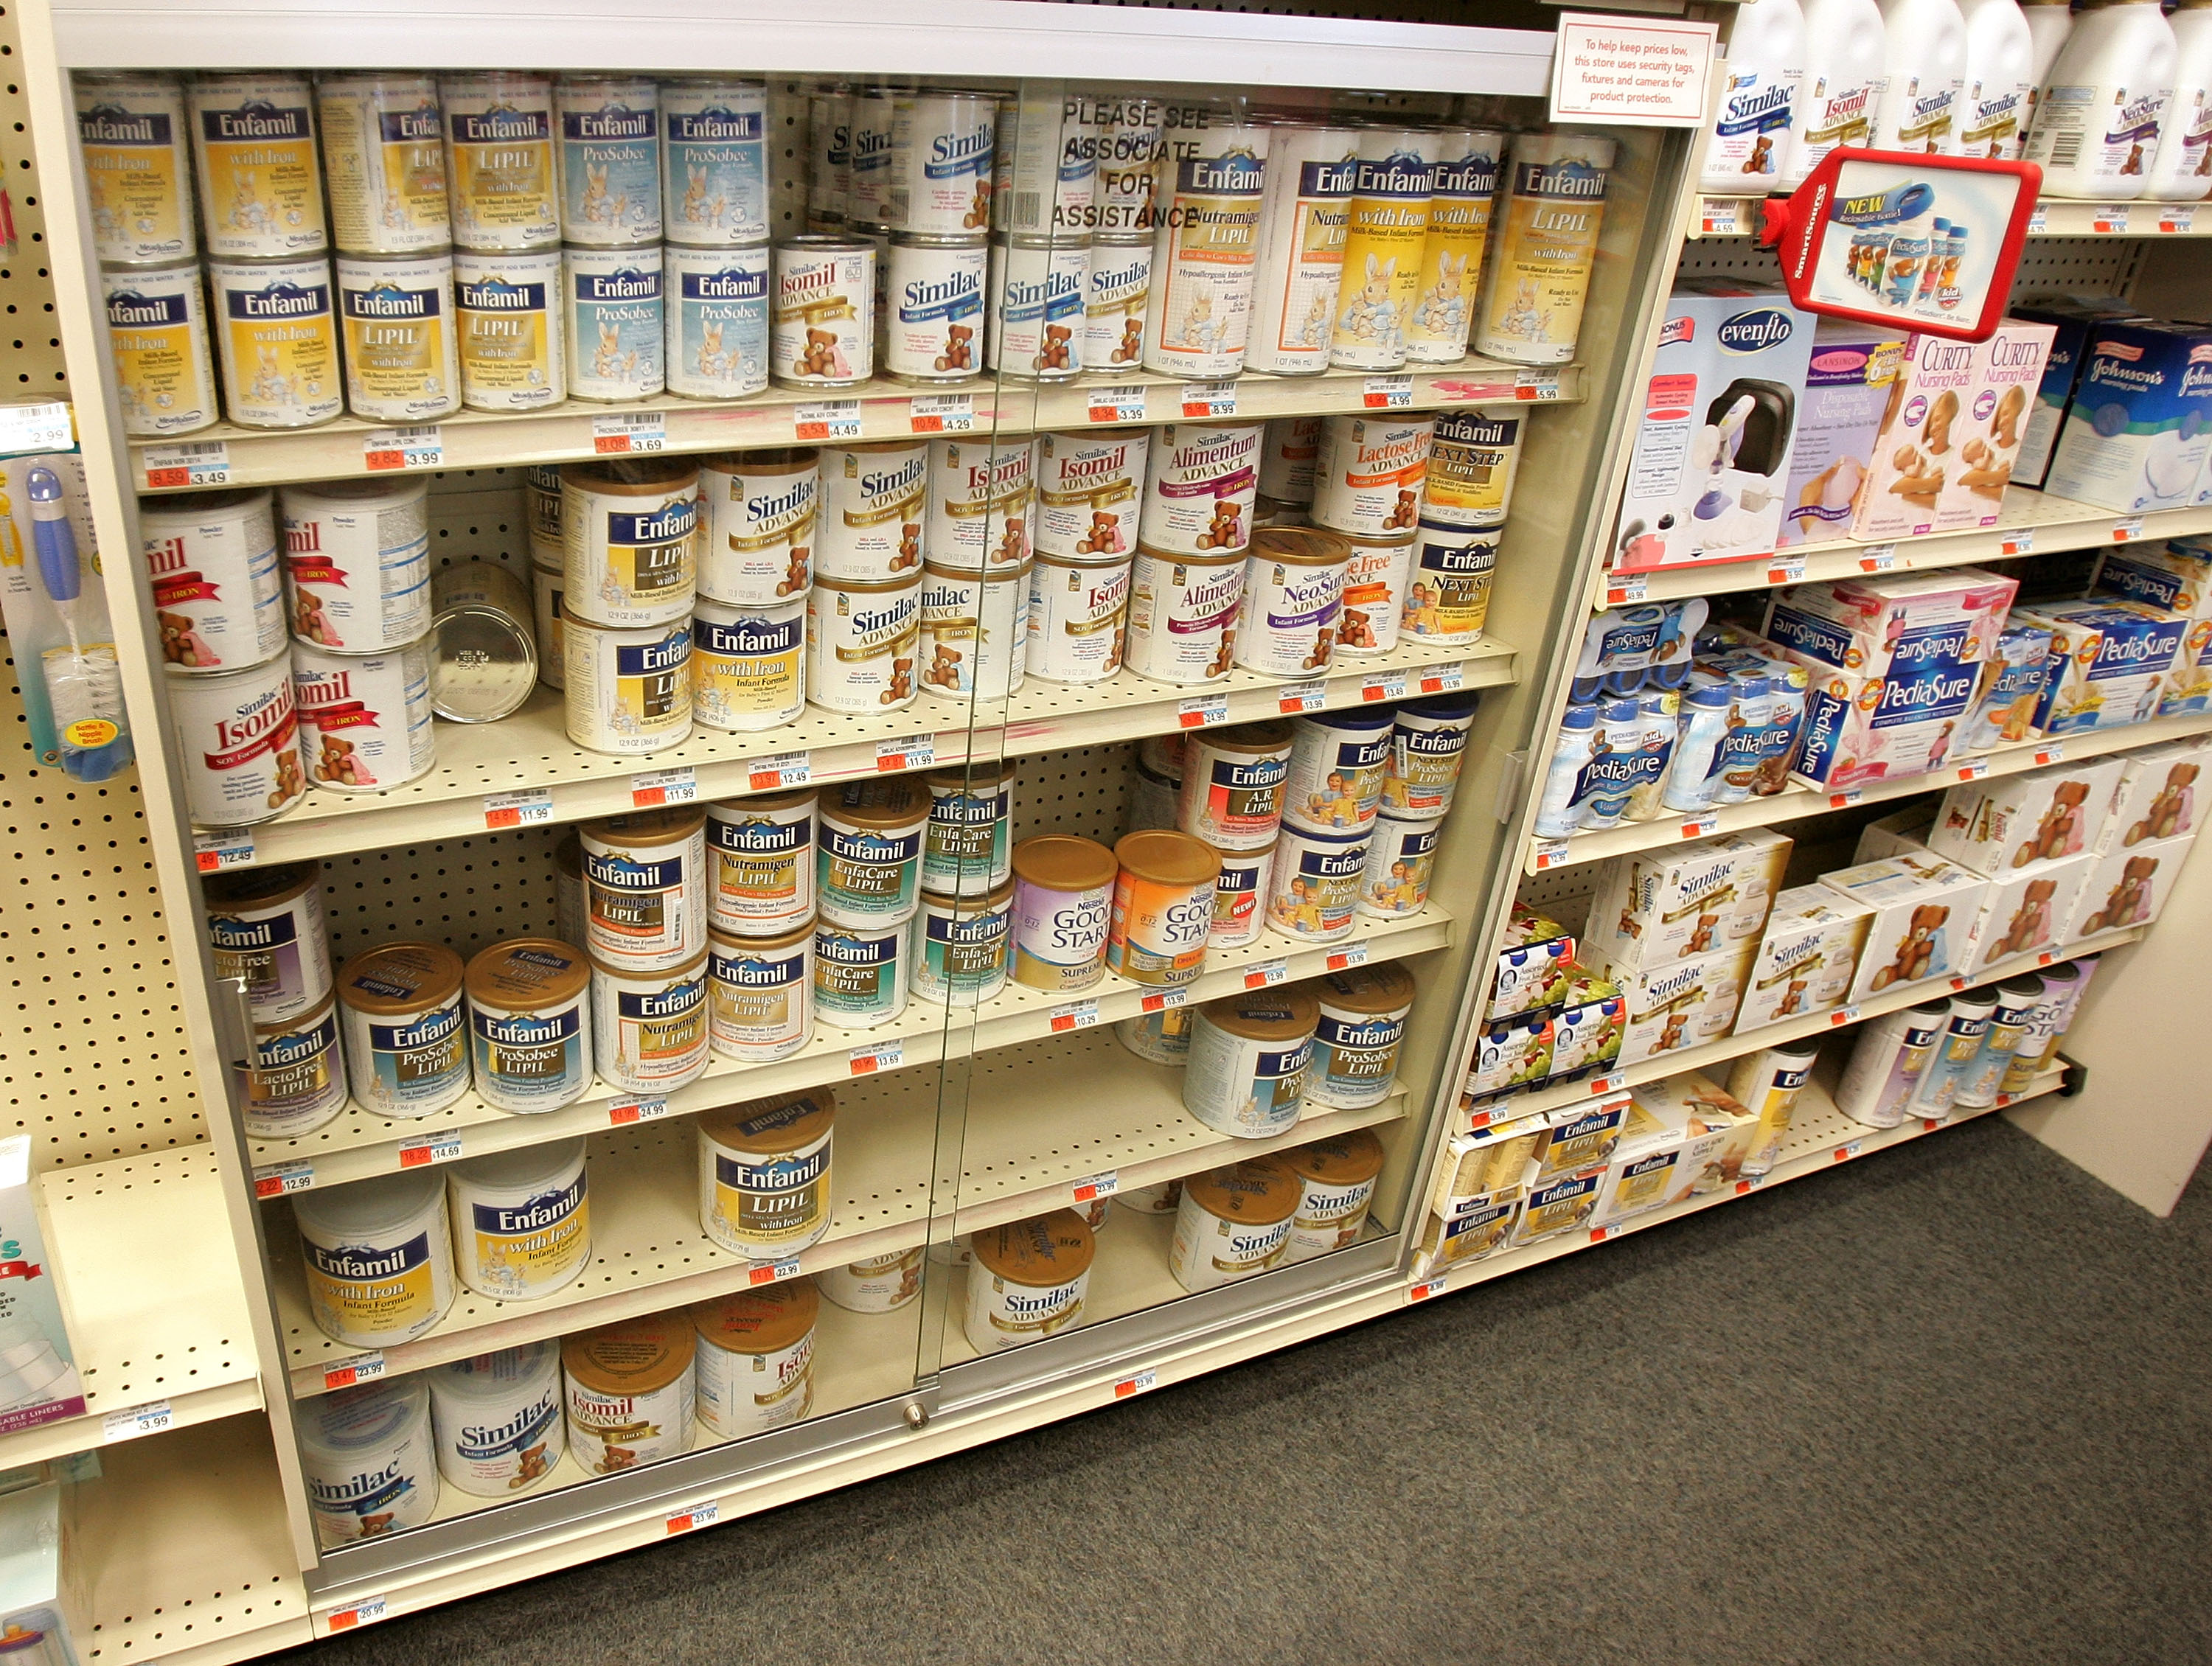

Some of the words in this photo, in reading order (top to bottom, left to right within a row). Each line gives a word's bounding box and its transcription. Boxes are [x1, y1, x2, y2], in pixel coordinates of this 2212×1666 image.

[1586, 38, 1596, 50] To
[1599, 40, 1617, 52] help
[1621, 41, 1641, 55] keep
[1644, 43, 1668, 56] prices
[1672, 44, 1688, 56] low,
[1575, 55, 1590, 66] this
[1593, 58, 1615, 68] store
[1618, 60, 1636, 69] uses
[1639, 60, 1672, 73] security
[1675, 63, 1694, 74] tags,
[1582, 72, 1614, 84] fixtures
[1617, 74, 1632, 85] and
[1635, 77, 1669, 87] cameras
[1672, 78, 1685, 88] for
[1590, 91, 1624, 102] product
[1627, 93, 1672, 104] protection.
[1725, 86, 1796, 122] Similac
[1825, 87, 1870, 119] Isomil
[1913, 90, 1956, 117] Similac
[1975, 91, 2021, 120] Similac
[220, 113, 296, 137] Enfamil
[467, 116, 538, 138] Enfamil
[580, 115, 647, 136] Enfamil
[683, 118, 749, 136] Enfamil
[1064, 102, 1158, 127] PLEASE
[1164, 107, 1212, 130] SEE
[684, 148, 748, 162] ProSobee
[1064, 138, 1200, 162] ASSOCIATE
[1106, 173, 1152, 194] FOR
[1358, 165, 1433, 192] Enfamil
[1526, 167, 1604, 195] Enfamil
[1843, 195, 1887, 213] NEW
[1054, 206, 1198, 228] ASSISTANCE
[1358, 209, 1395, 226] with
[1531, 209, 1588, 231] LIPIL
[594, 276, 655, 296] Enfamil
[699, 276, 761, 296] Enfamil
[780, 262, 837, 295] Isomil
[1091, 261, 1152, 292] Similac
[463, 288, 529, 307] Enfamil
[904, 270, 981, 307] Similac
[1006, 271, 1082, 307] Similac
[245, 292, 318, 315] Enfamil
[355, 294, 424, 316] Enfamil
[596, 307, 654, 320] ProSobee
[700, 306, 759, 320] ProSobee
[254, 329, 290, 341] with
[292, 327, 318, 340] Iron
[365, 326, 419, 344] LIPIL
[473, 318, 523, 337] LIPIL
[1721, 310, 1790, 346] evenflo
[1817, 357, 1861, 366] LANSINOH
[1922, 340, 1976, 372] CURITY
[1991, 335, 2042, 367] CURITY
[1915, 372, 1949, 390] Nursing
[1950, 372, 1970, 387] Pads
[1984, 367, 2017, 385] Nursing
[2017, 367, 2038, 382] Pads
[2090, 358, 2163, 386] Johnson's
[1197, 433, 1236, 447] Similac
[1356, 438, 1407, 464] Lactose
[1058, 446, 1126, 479] Isomil
[1075, 447, 1112, 460] Similac
[1169, 435, 1256, 470] Alimentum
[1469, 450, 1504, 467] STEP
[860, 456, 926, 499] Similac
[1180, 456, 1249, 481] ADVANCE
[1058, 470, 1121, 491] ADVANCE
[1357, 555, 1391, 573] Free
[852, 593, 918, 635] Similac
[712, 627, 789, 649] Enfamil
[1773, 617, 1845, 660] PediaSure
[1896, 635, 1964, 662] PediaSure
[2098, 632, 2177, 663] PediaSure
[717, 663, 751, 676] with
[755, 661, 785, 677] Iron
[737, 677, 759, 688] Infant
[1881, 674, 1970, 709] PediaSure
[215, 675, 293, 750] Isomil
[236, 686, 278, 720] Similac
[1721, 729, 1789, 761] PediaSure
[1806, 697, 1841, 773] PediaSure
[1231, 758, 1286, 784] Enfamil
[1582, 756, 1660, 788] PediaSure
[1250, 790, 1274, 804] A.R.
[722, 826, 796, 848] Enfamil
[832, 834, 905, 860] Enfamil
[588, 861, 660, 886] Enfamil
[723, 854, 795, 871] Nutramigen
[835, 861, 897, 879] EnfaCare
[737, 871, 777, 885] LIPIL
[845, 876, 885, 891] LIPIL
[1677, 860, 1736, 899] Similac
[1770, 930, 1824, 965] Similac
[716, 958, 787, 984] Enfamil
[1646, 964, 1705, 1001] Similac
[641, 980, 705, 1016] Enfamil
[720, 991, 785, 1005] Nutramigen
[393, 1006, 461, 1048] Enfamil
[486, 1020, 562, 1043] Enfamil
[1336, 1022, 1403, 1045] Enfamil
[417, 1055, 452, 1075] LIPIL
[494, 1047, 558, 1062] ProSobee
[505, 1060, 546, 1074] LIPIL
[1564, 1116, 1609, 1138] Enfamil
[737, 1155, 820, 1189] Enfamil
[1632, 1155, 1670, 1175] Enfamil
[752, 1194, 808, 1213] LIPIL
[1305, 1181, 1370, 1210] Similac
[1542, 1182, 1585, 1204] Enfamil
[498, 1185, 579, 1231] Enfamil
[1229, 1217, 1293, 1252] Similac
[315, 1251, 406, 1277] Enfamil
[328, 1285, 361, 1299] with
[365, 1280, 405, 1299] Iron
[1004, 1280, 1077, 1311] Similac
[343, 1299, 372, 1310] Infant
[29, 1404, 63, 1417] LINERS
[572, 1390, 633, 1414] Isomil
[462, 1389, 552, 1447] Similac
